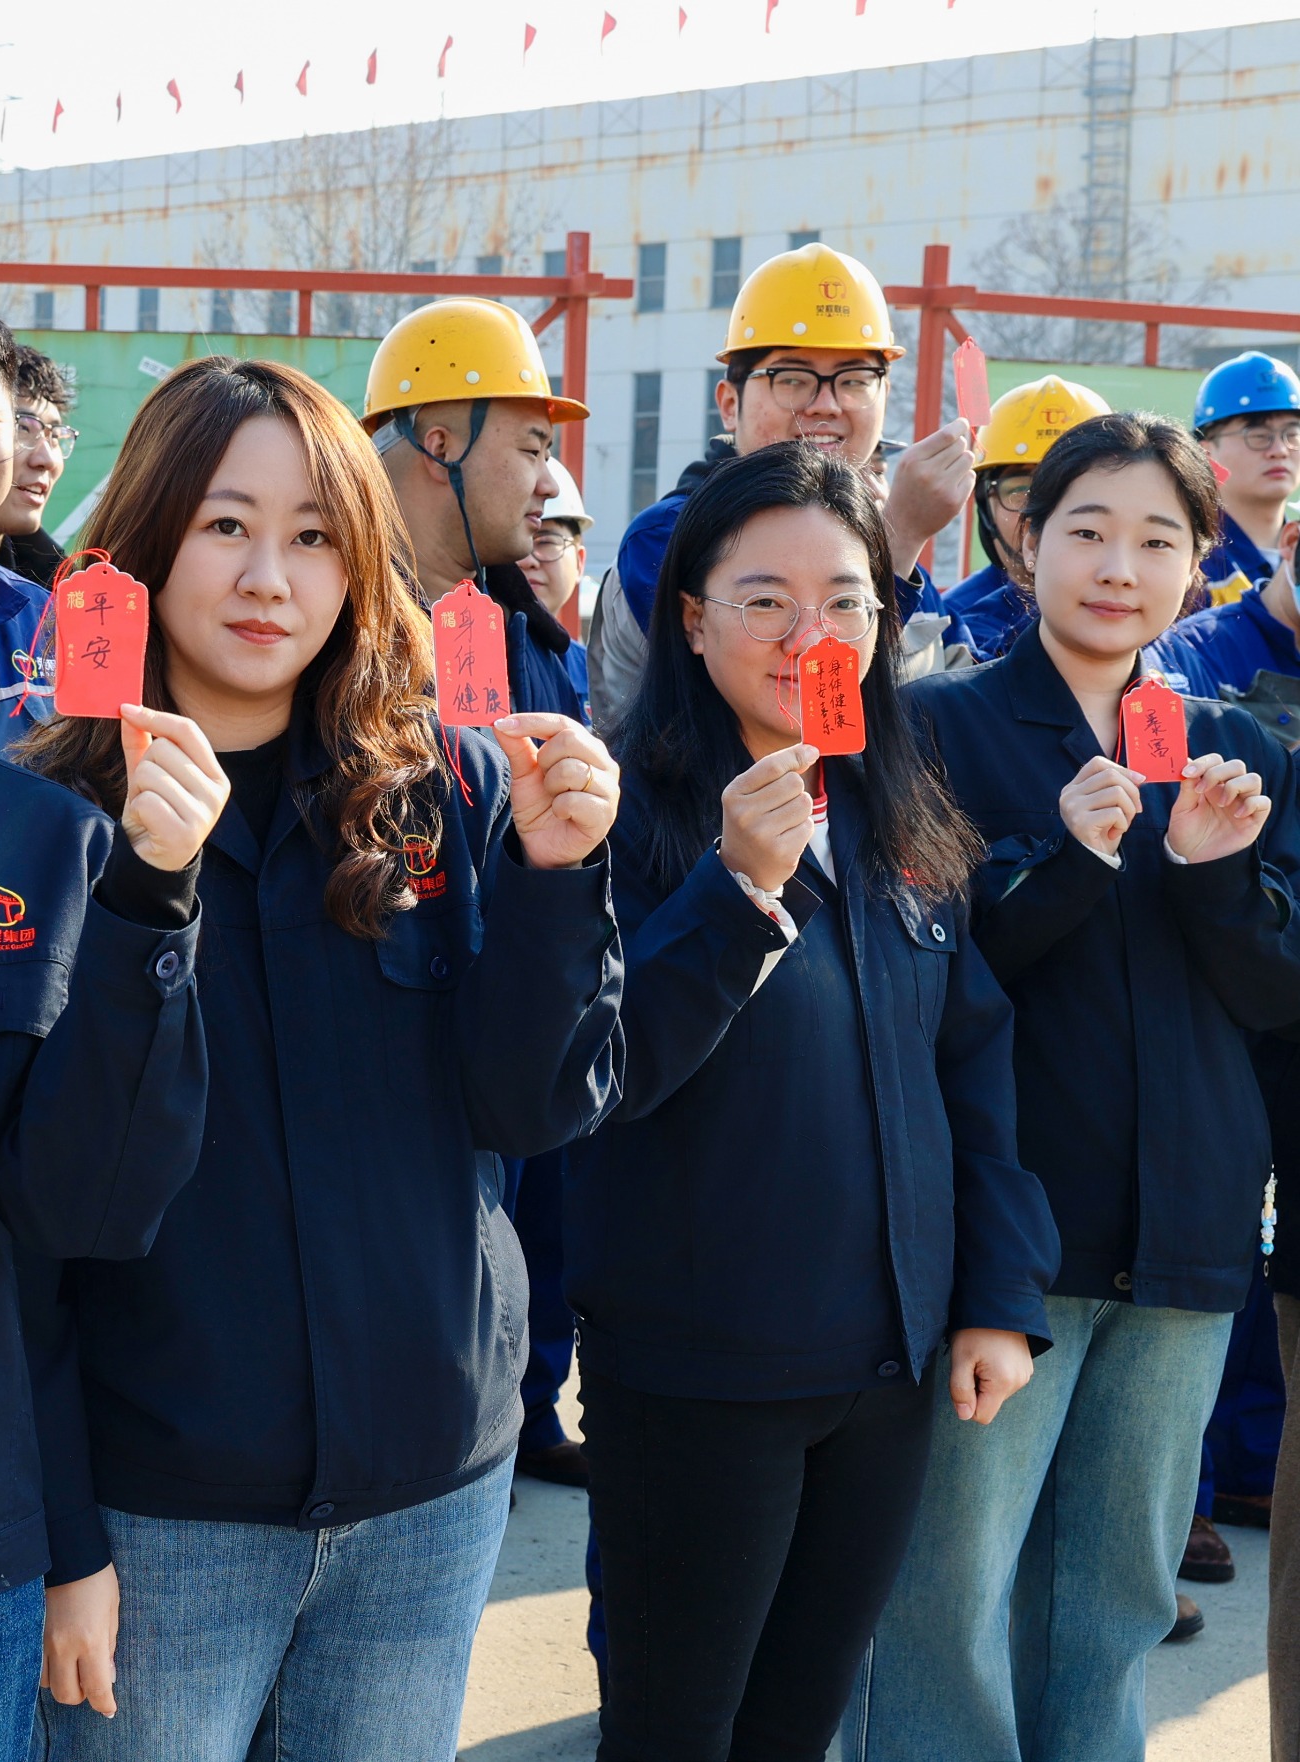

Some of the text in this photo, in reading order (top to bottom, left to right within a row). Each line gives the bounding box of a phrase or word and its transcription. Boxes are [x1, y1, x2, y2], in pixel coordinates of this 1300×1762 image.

[81, 592, 115, 669] 平安
[816, 660, 835, 735] 平安喜乐
[828, 656, 856, 729] 身体健康
